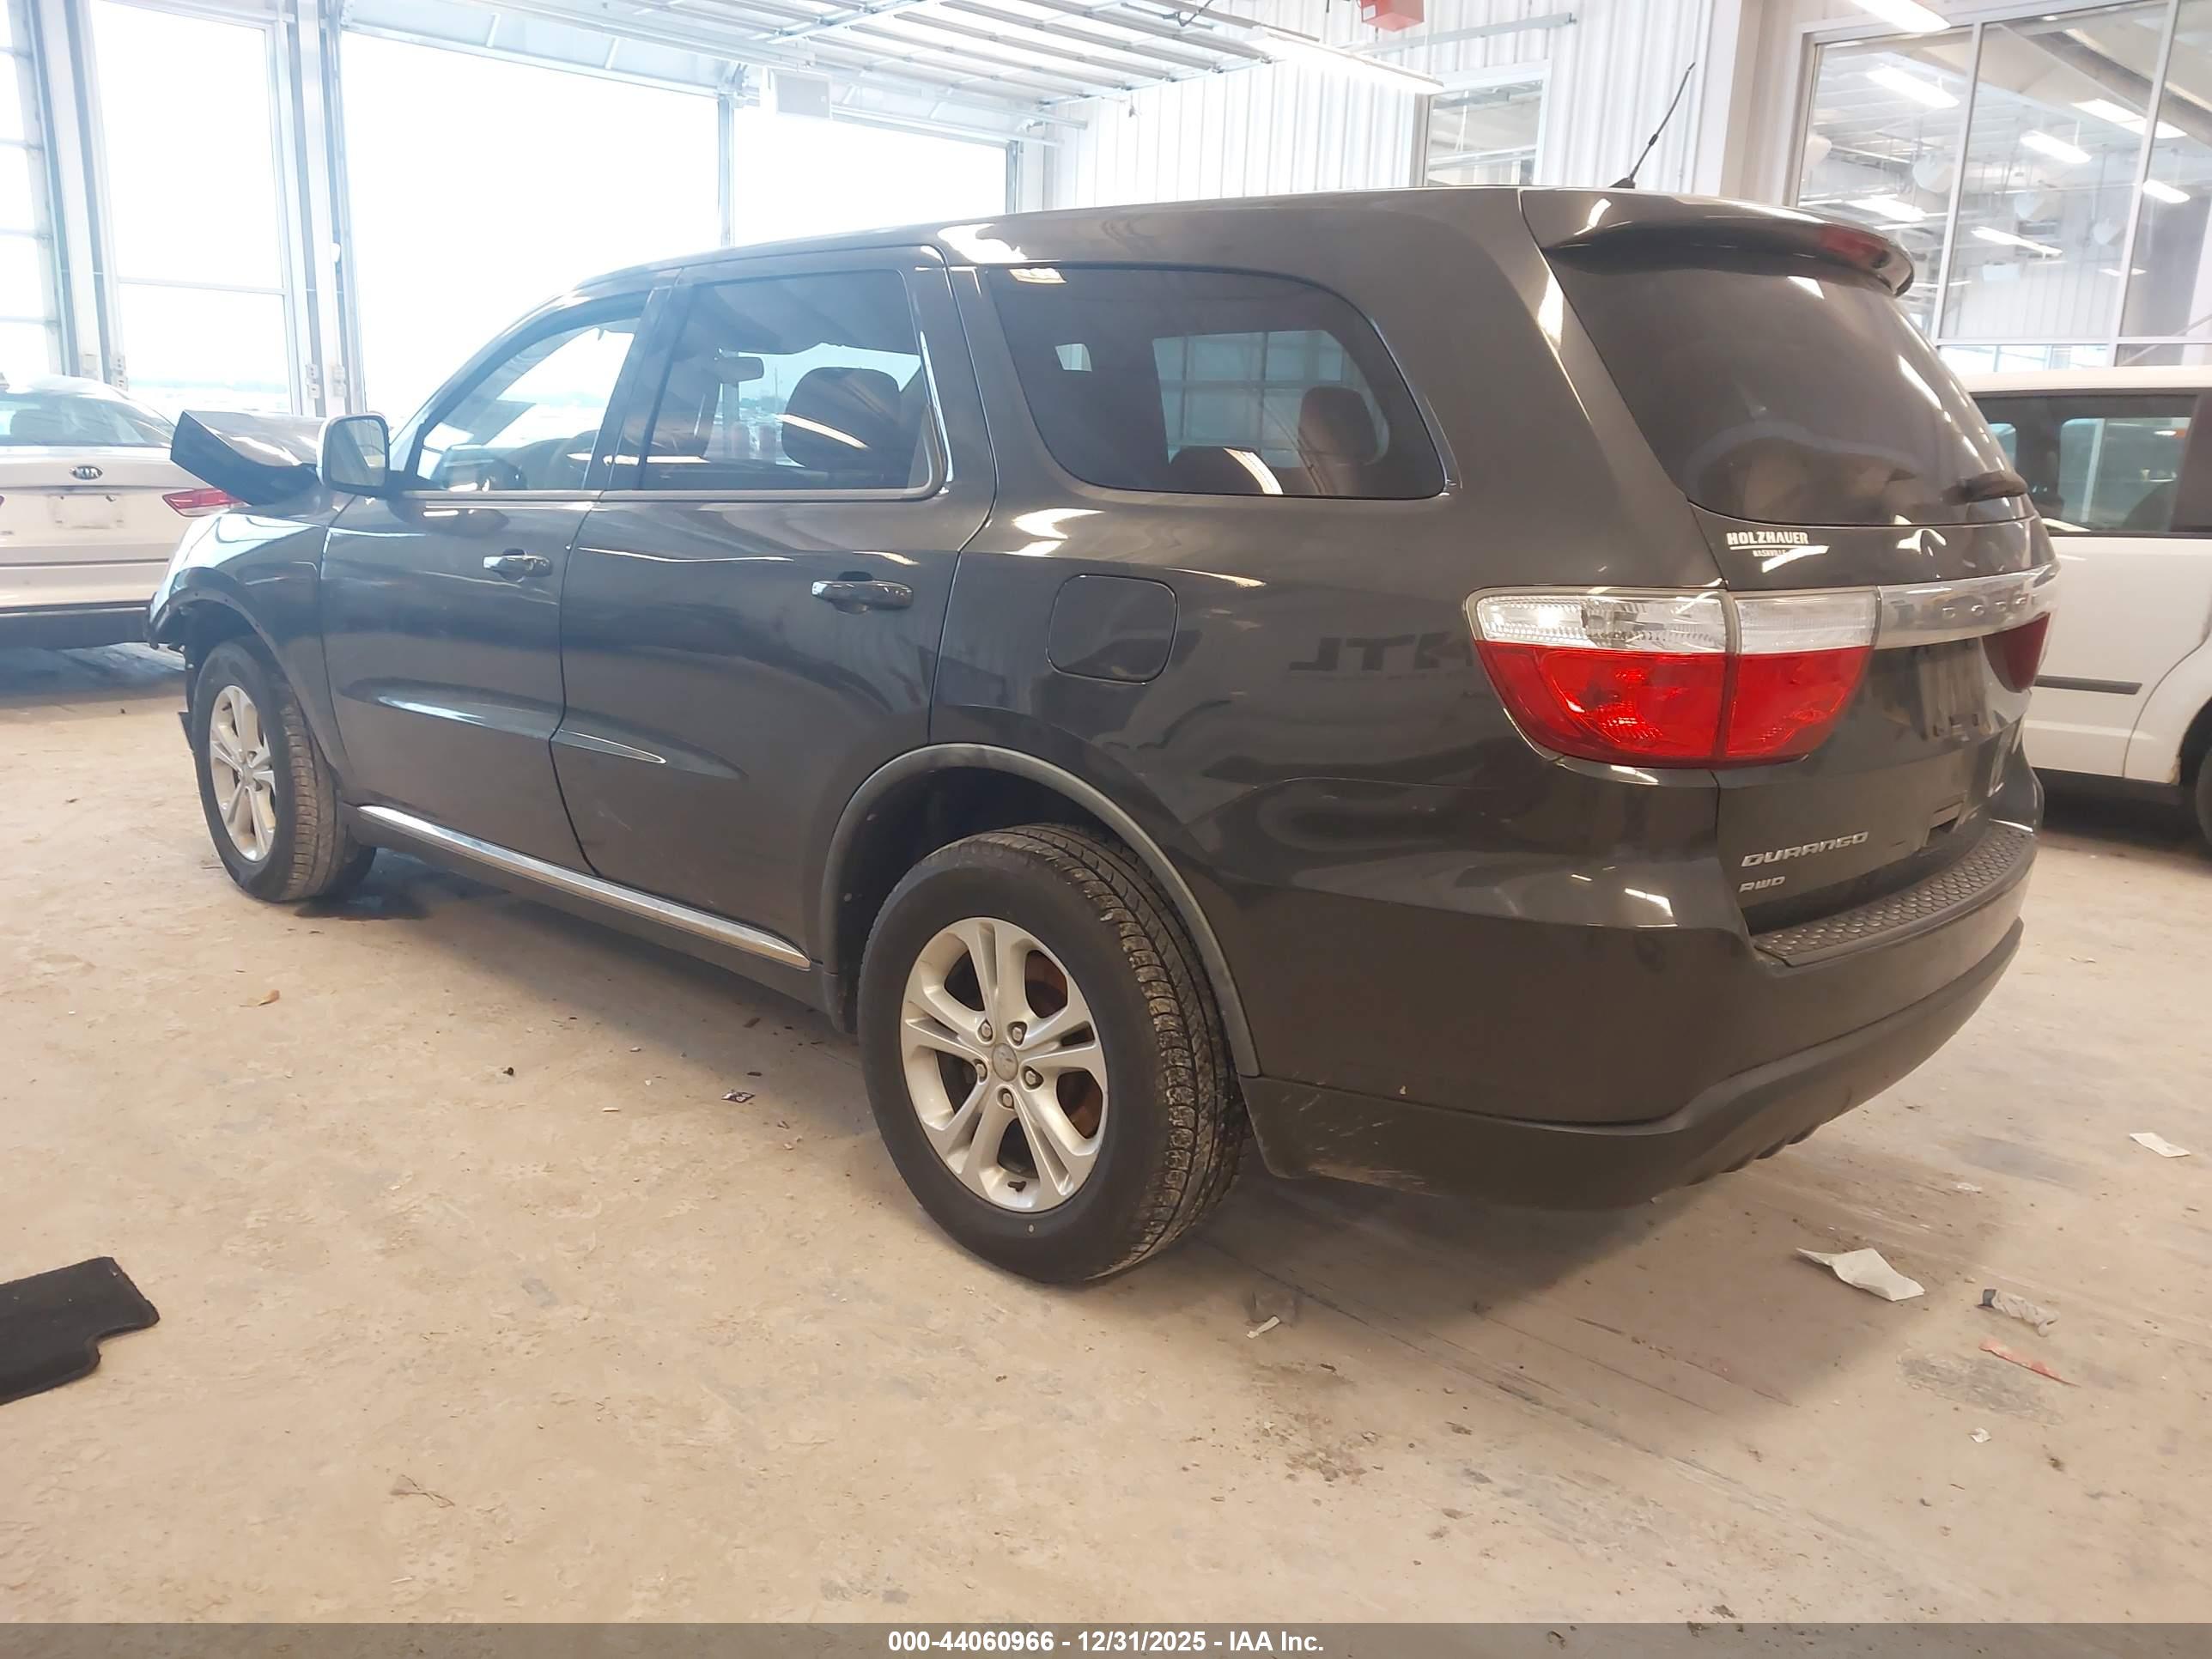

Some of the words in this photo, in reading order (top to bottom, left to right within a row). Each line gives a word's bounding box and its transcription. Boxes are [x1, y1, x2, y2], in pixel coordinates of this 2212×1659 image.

[74, 466, 100, 479] KIA
[1726, 531, 1809, 545] HOLZHAUER
[1741, 831, 1869, 867] DURANGO
[1738, 876, 1786, 893] RWD
